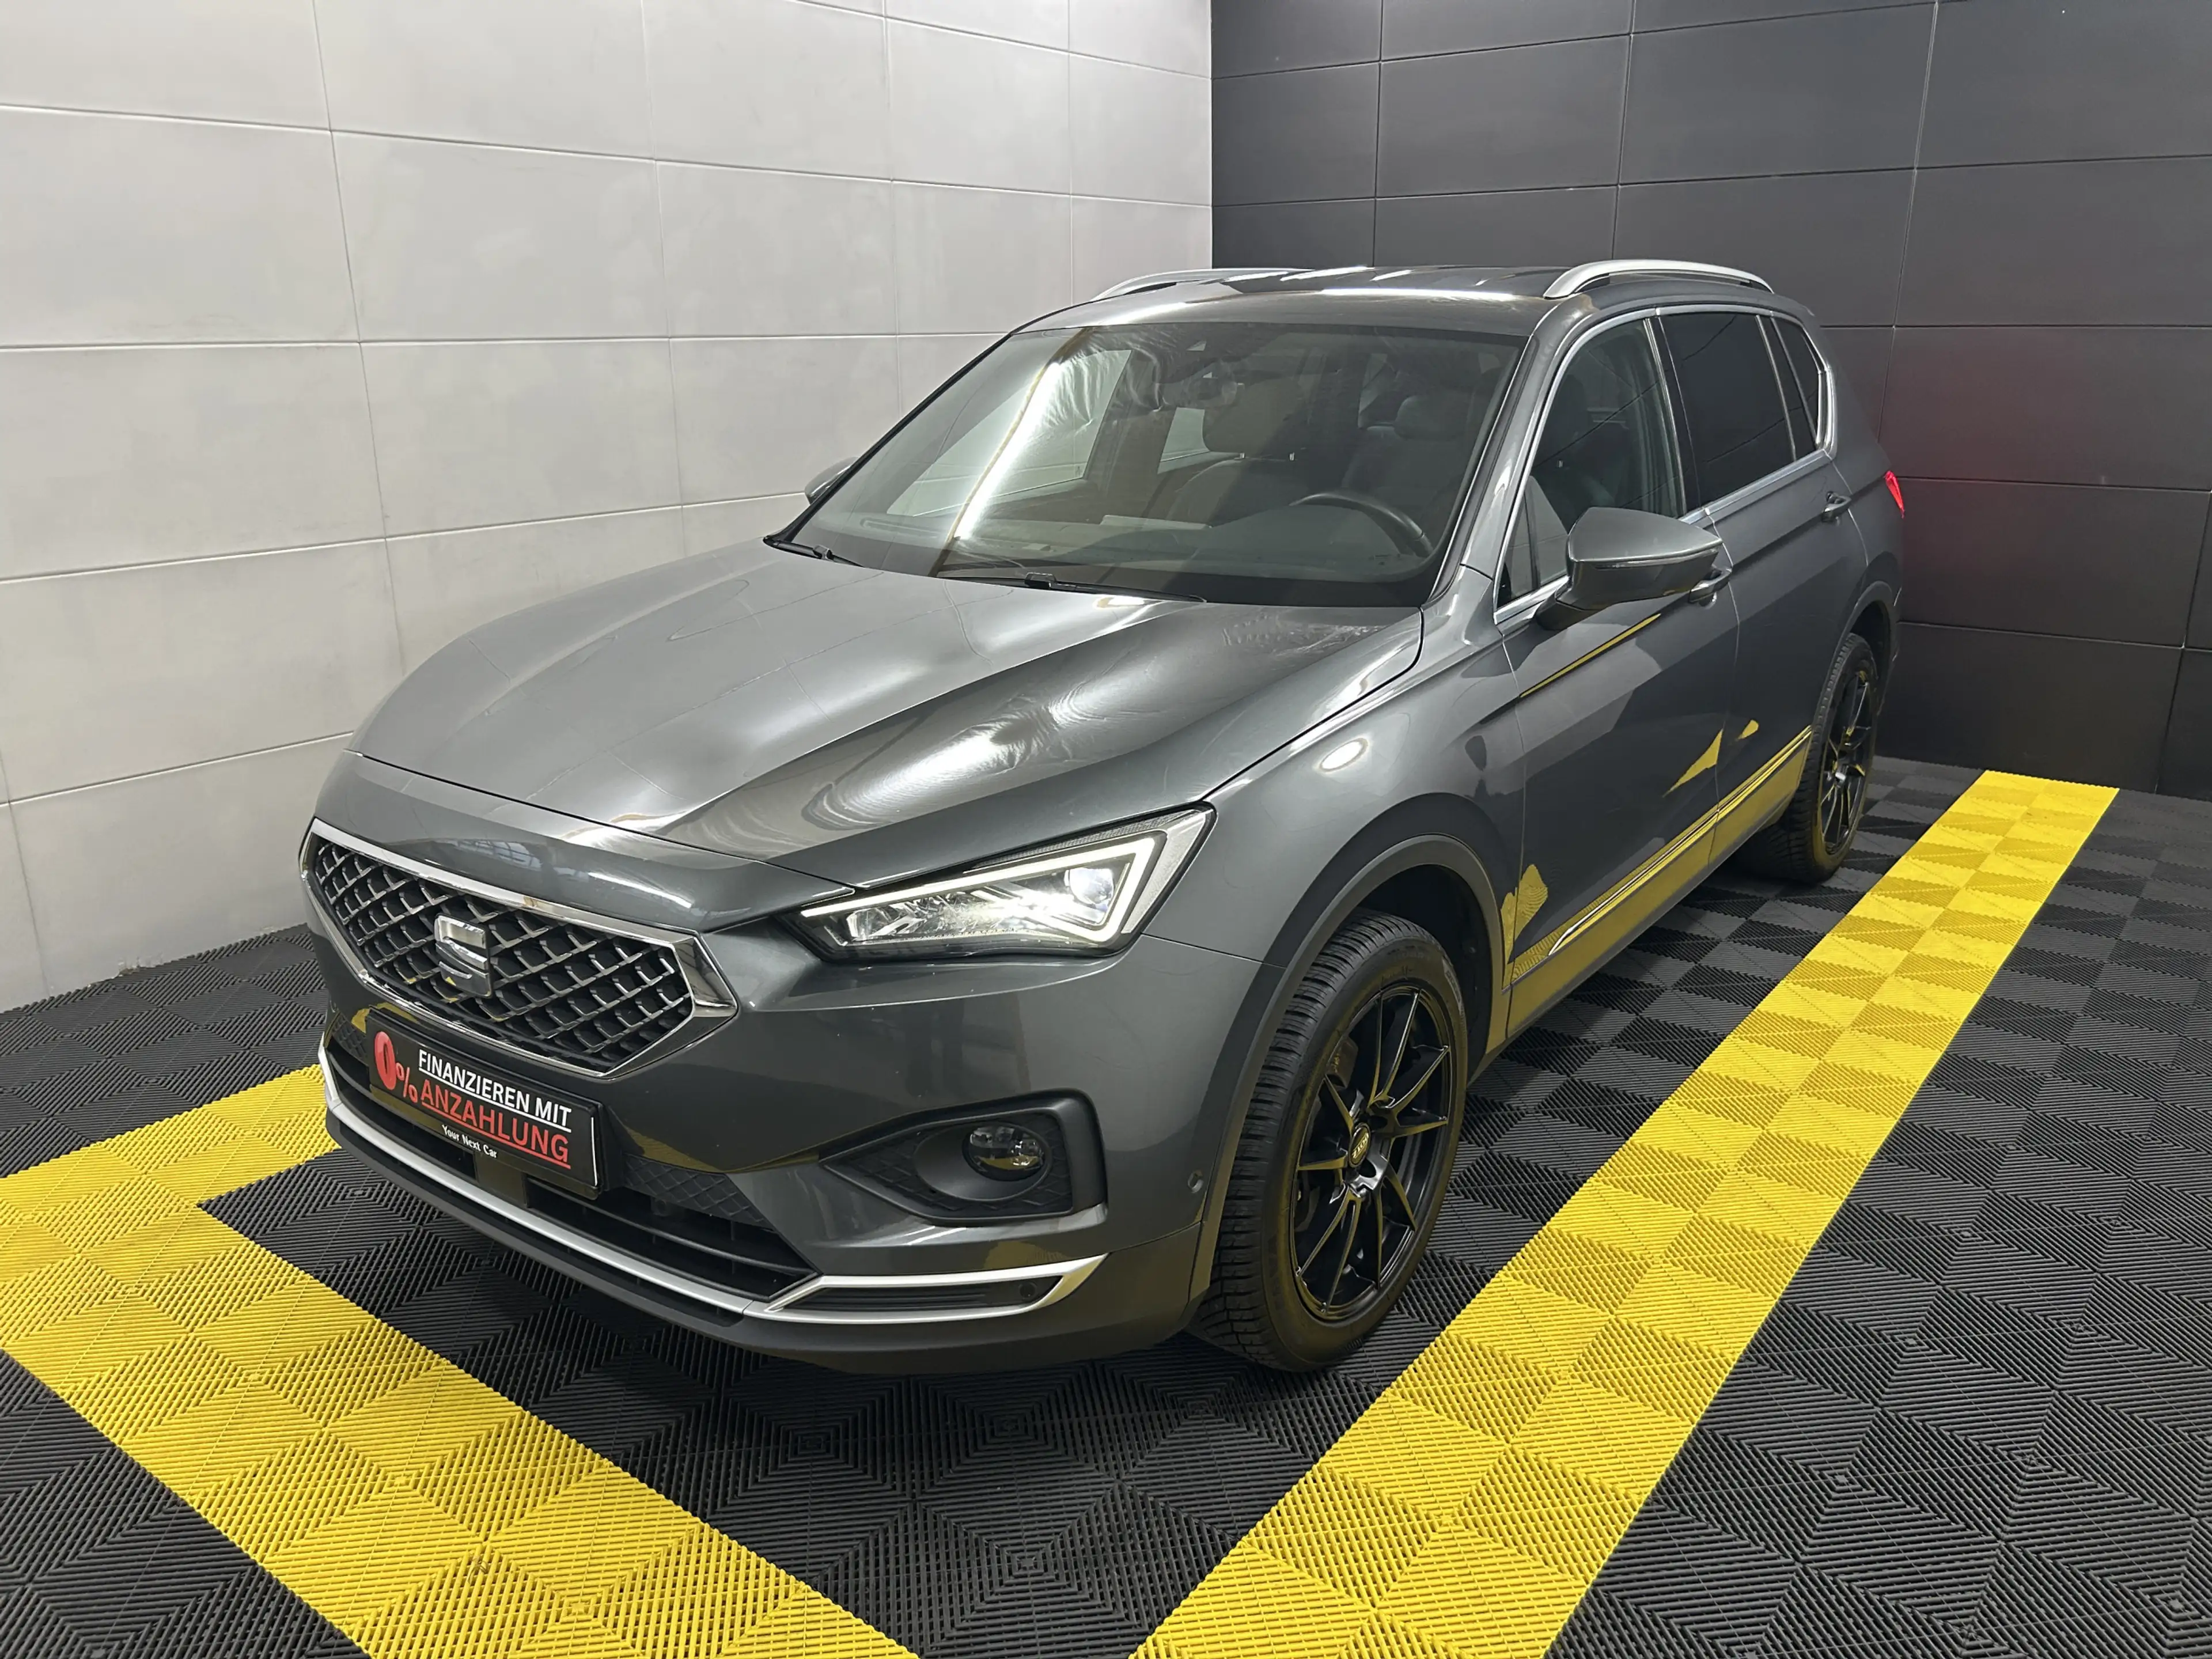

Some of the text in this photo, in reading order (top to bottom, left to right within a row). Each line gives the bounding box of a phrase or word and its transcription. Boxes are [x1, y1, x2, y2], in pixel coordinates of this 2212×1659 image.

[419, 1049, 571, 1126] FINANZIEREN MIT
[421, 1079, 569, 1162] ANZAHLUNG
[442, 1124, 497, 1158] Your Next Car
